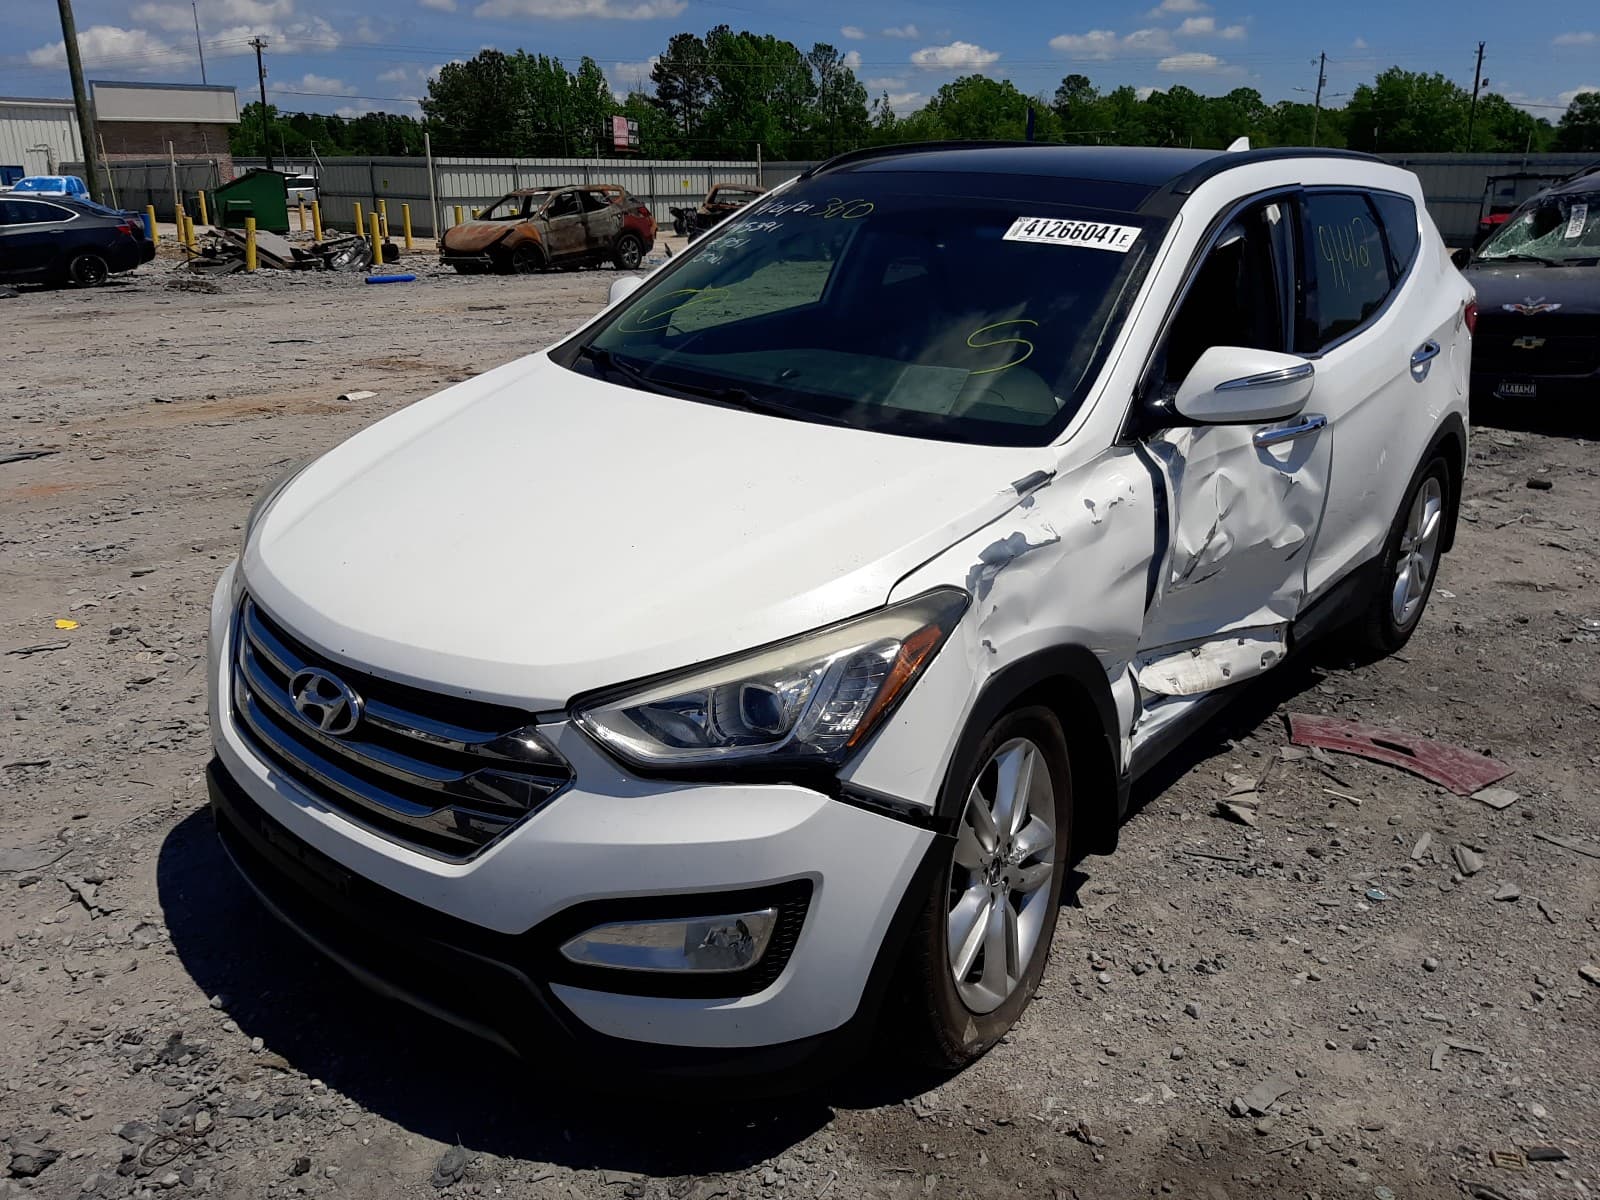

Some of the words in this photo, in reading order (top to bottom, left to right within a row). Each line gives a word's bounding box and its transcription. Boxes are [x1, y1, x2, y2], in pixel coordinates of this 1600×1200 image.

[810, 197, 875, 219] 360
[1023, 219, 1121, 245] 41266041
[1500, 384, 1535, 393] ALABAMA
